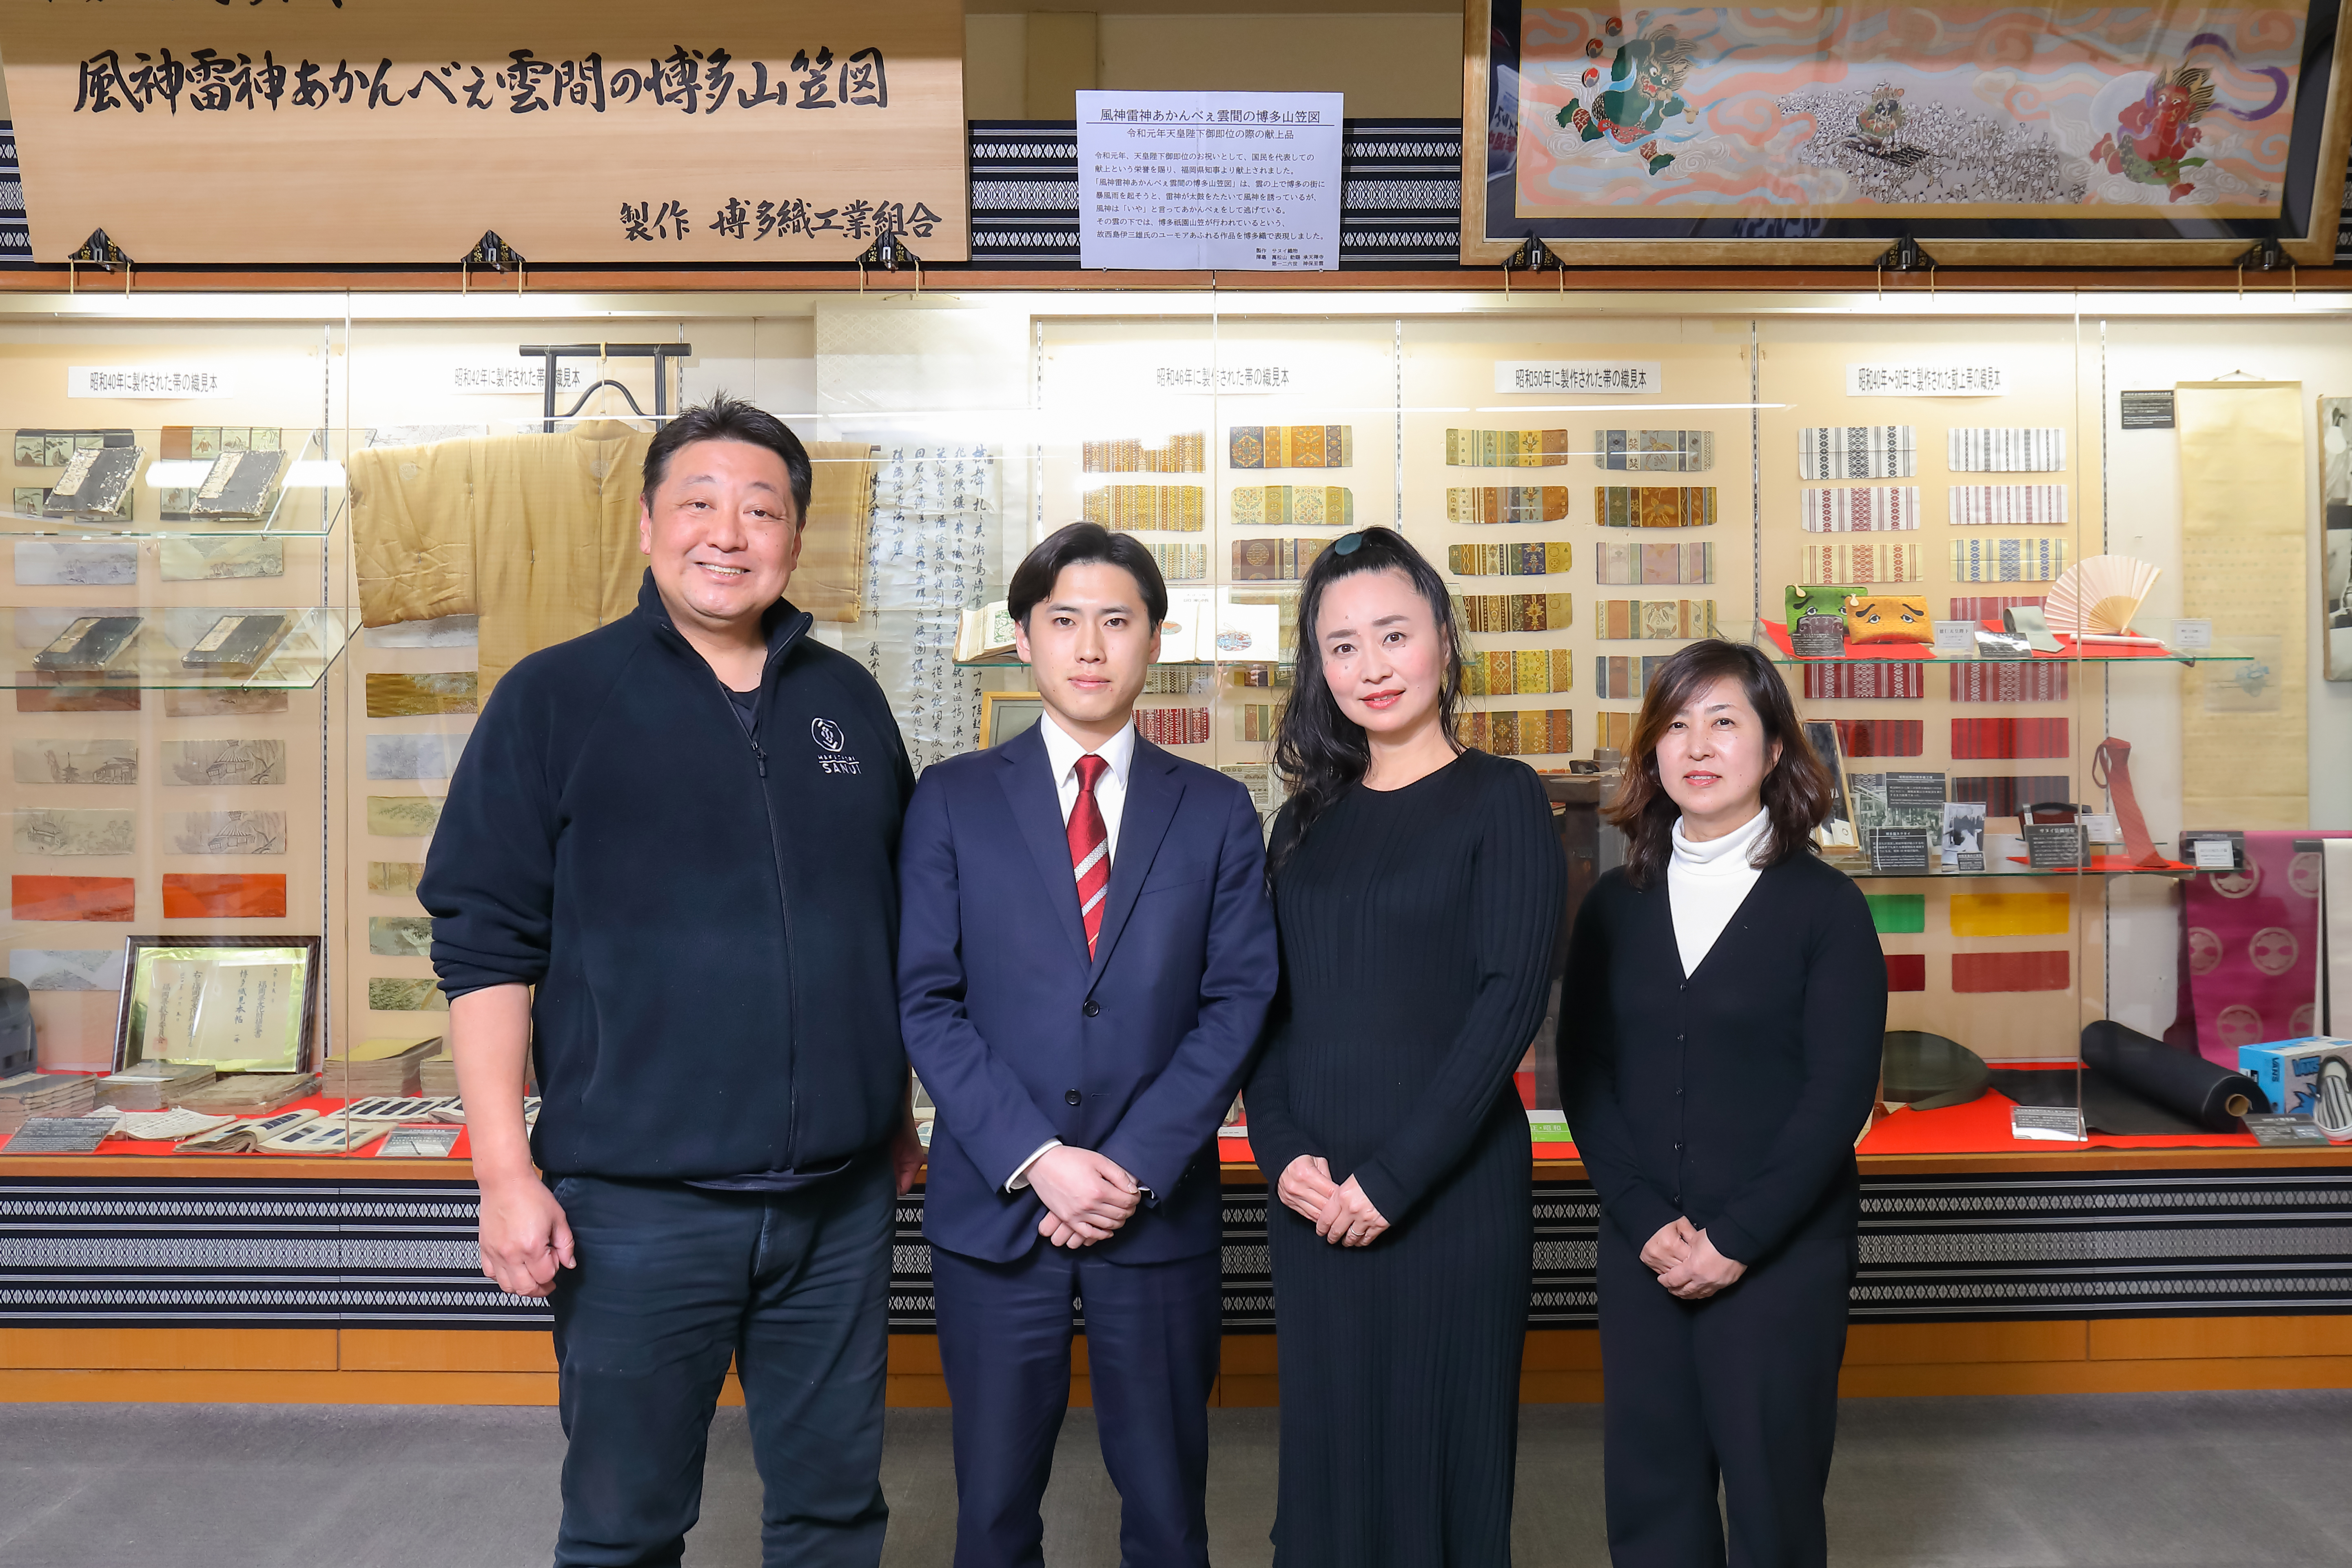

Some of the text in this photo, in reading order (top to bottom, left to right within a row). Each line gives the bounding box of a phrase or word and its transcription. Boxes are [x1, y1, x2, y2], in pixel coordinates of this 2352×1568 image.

[1100, 108, 1320, 124] 風神雷神あかんべぇ雲間の博多山笠図
[1126, 128, 1294, 140] 令和元年天皇陛下御即位の際の献上品
[619, 197, 942, 242] 製作 博多織工業組合
[90, 372, 217, 393] 昭和40年に製作された帯の織見本
[455, 367, 580, 388] 昭和42年に製作された帯織見本
[1515, 368, 1647, 389] 昭和50年に製作された帯の織見本
[822, 763, 862, 775] SANUI
[2272, 1057, 2280, 1082] VANS
